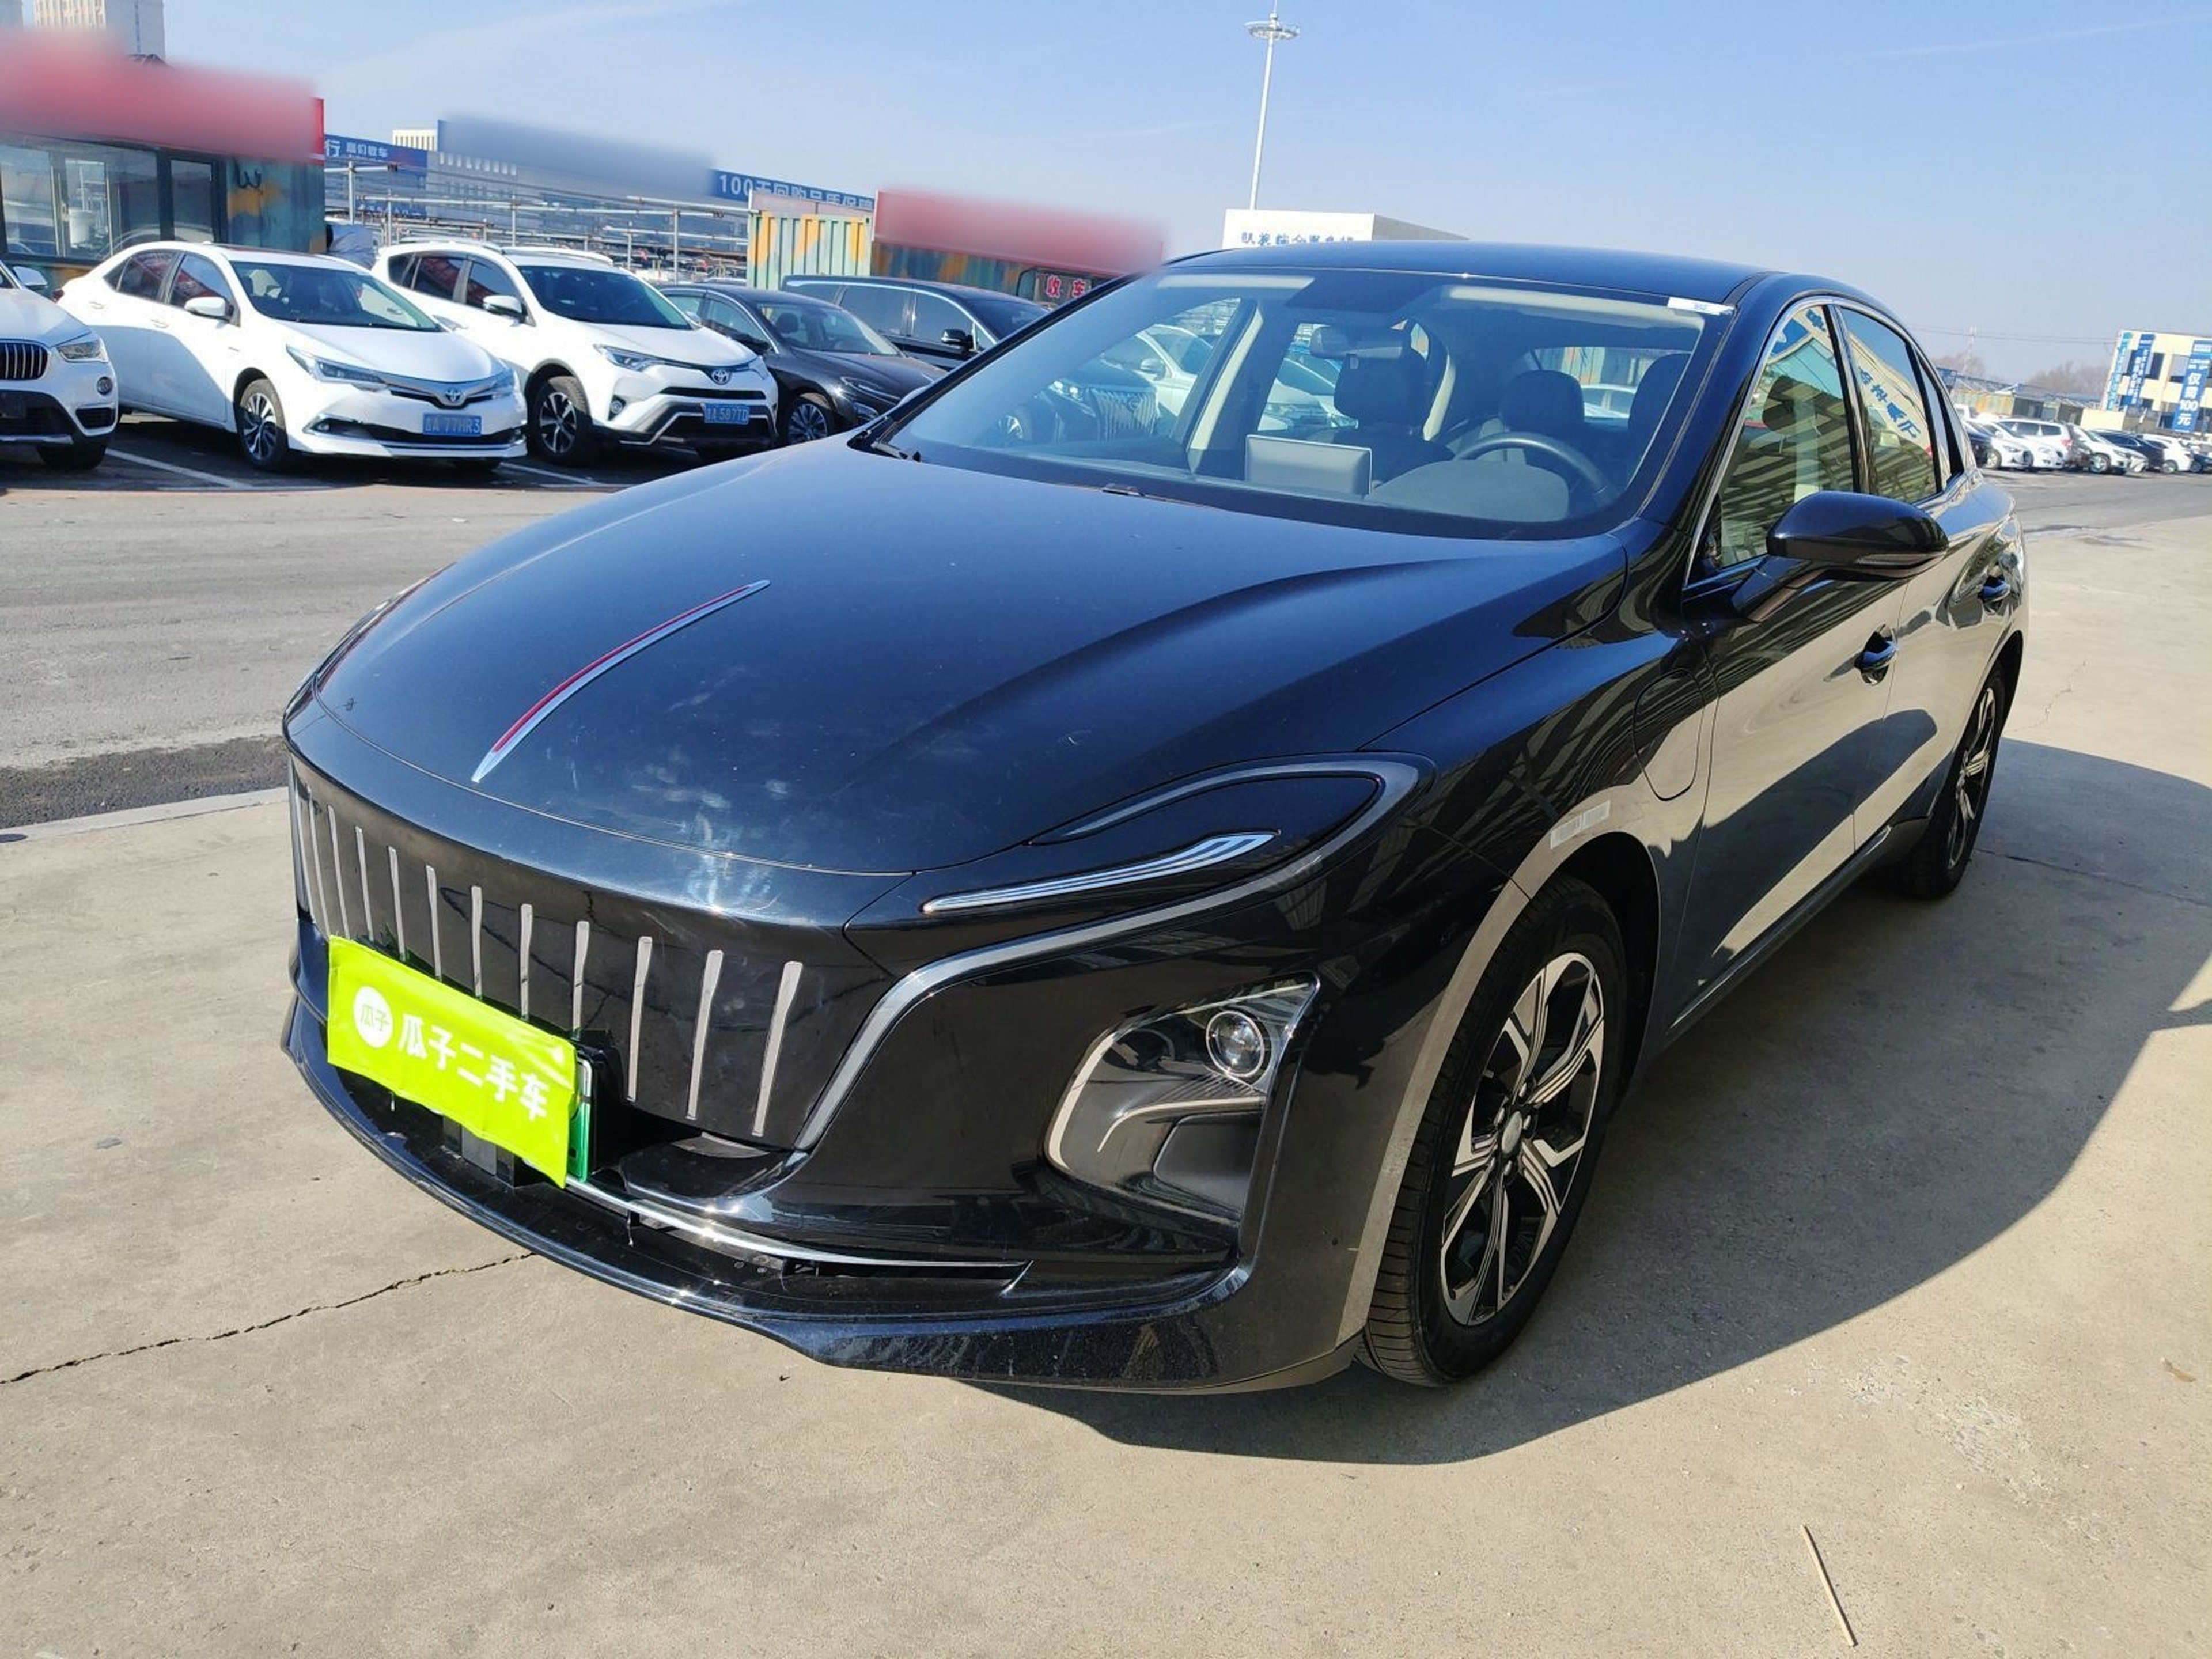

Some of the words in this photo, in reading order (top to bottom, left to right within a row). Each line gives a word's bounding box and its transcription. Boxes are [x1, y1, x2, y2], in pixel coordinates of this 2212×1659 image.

[1047, 275, 1085, 298] 收车
[359, 1003, 390, 1034] 瓜子
[397, 1013, 551, 1122] 瓜子二手车
